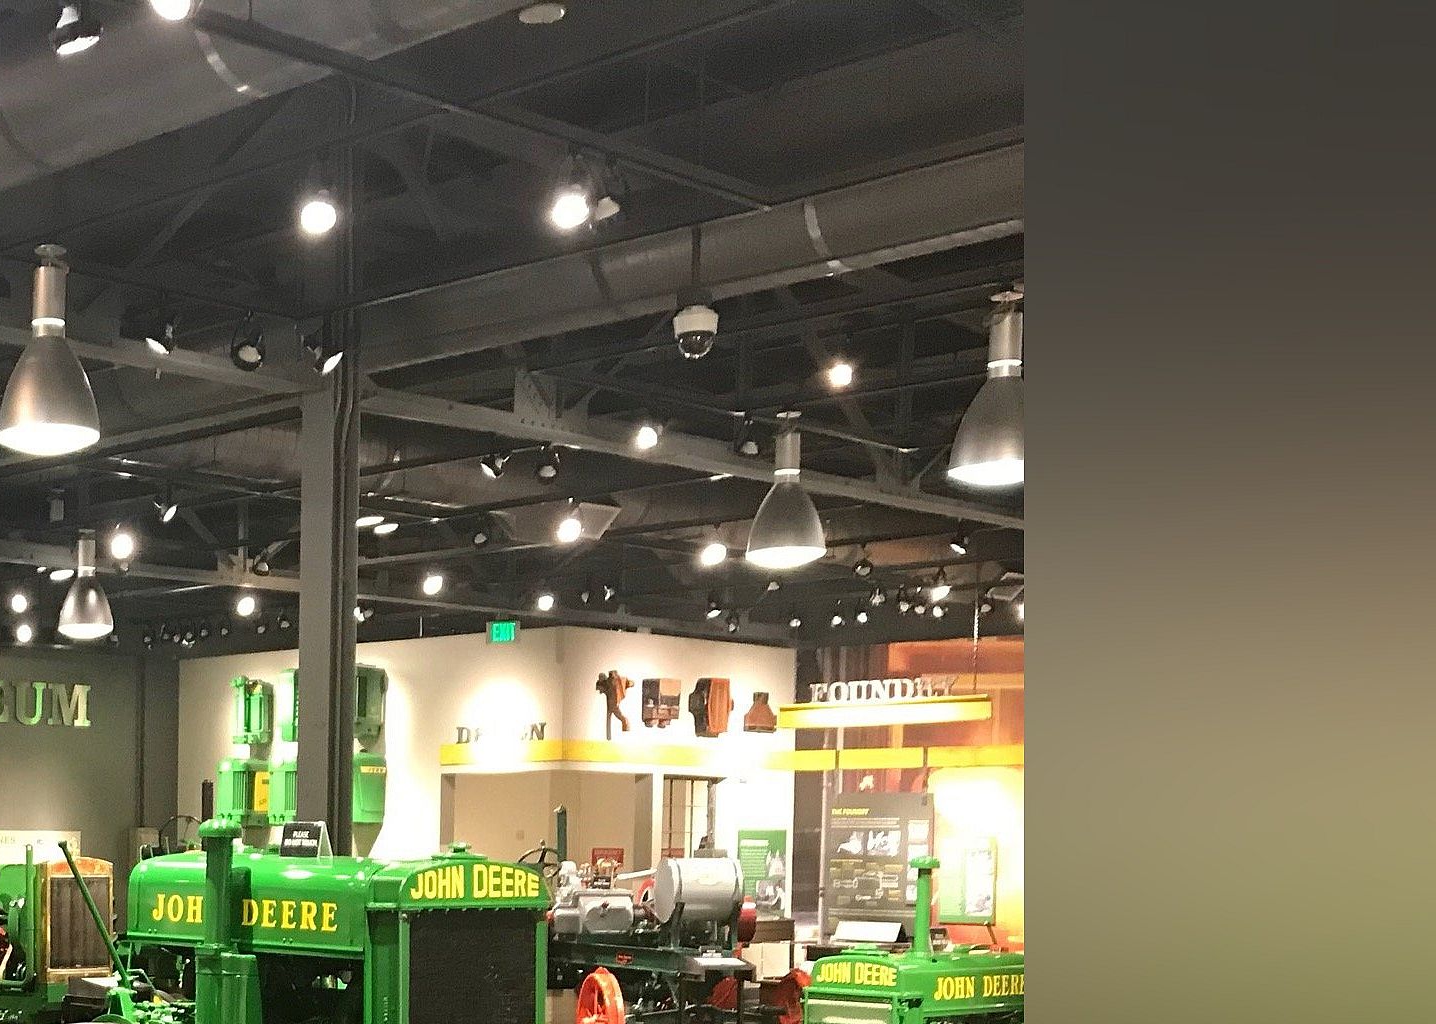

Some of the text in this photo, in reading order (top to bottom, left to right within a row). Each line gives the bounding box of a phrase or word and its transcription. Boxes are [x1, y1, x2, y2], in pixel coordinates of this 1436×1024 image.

[492, 622, 516, 642] EXIT
[410, 864, 541, 900] JOHN DEERE
[152, 893, 339, 932] JOH DEERE
[816, 961, 898, 987] JOHN DEERE
[933, 976, 976, 1001] JOHN
